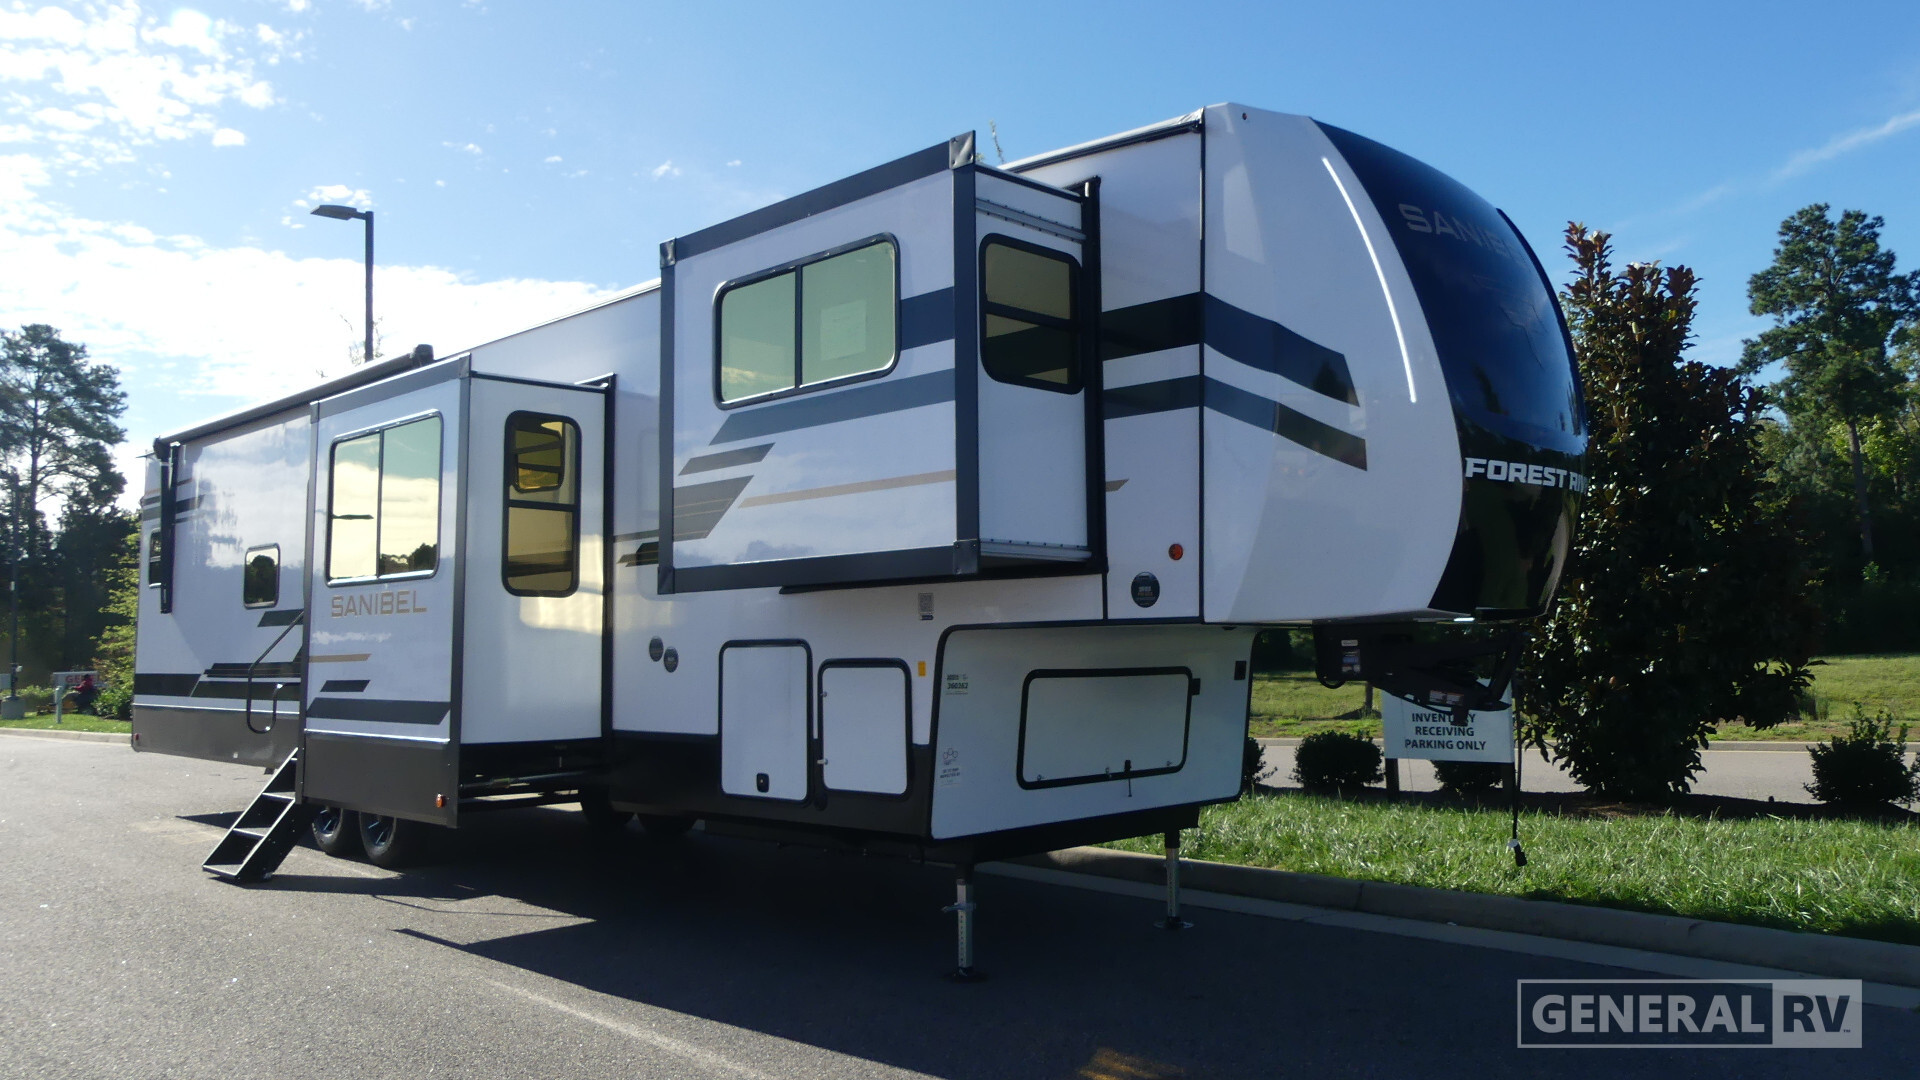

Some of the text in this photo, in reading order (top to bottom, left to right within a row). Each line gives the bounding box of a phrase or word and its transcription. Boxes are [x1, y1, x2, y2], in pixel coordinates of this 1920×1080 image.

[1465, 457, 1568, 489] FOREST
[331, 590, 427, 618] SANIBEL
[1412, 713, 1476, 723] INVENTY
[1415, 726, 1475, 737] RECEIVING
[1404, 738, 1487, 750] PARKING ONLY
